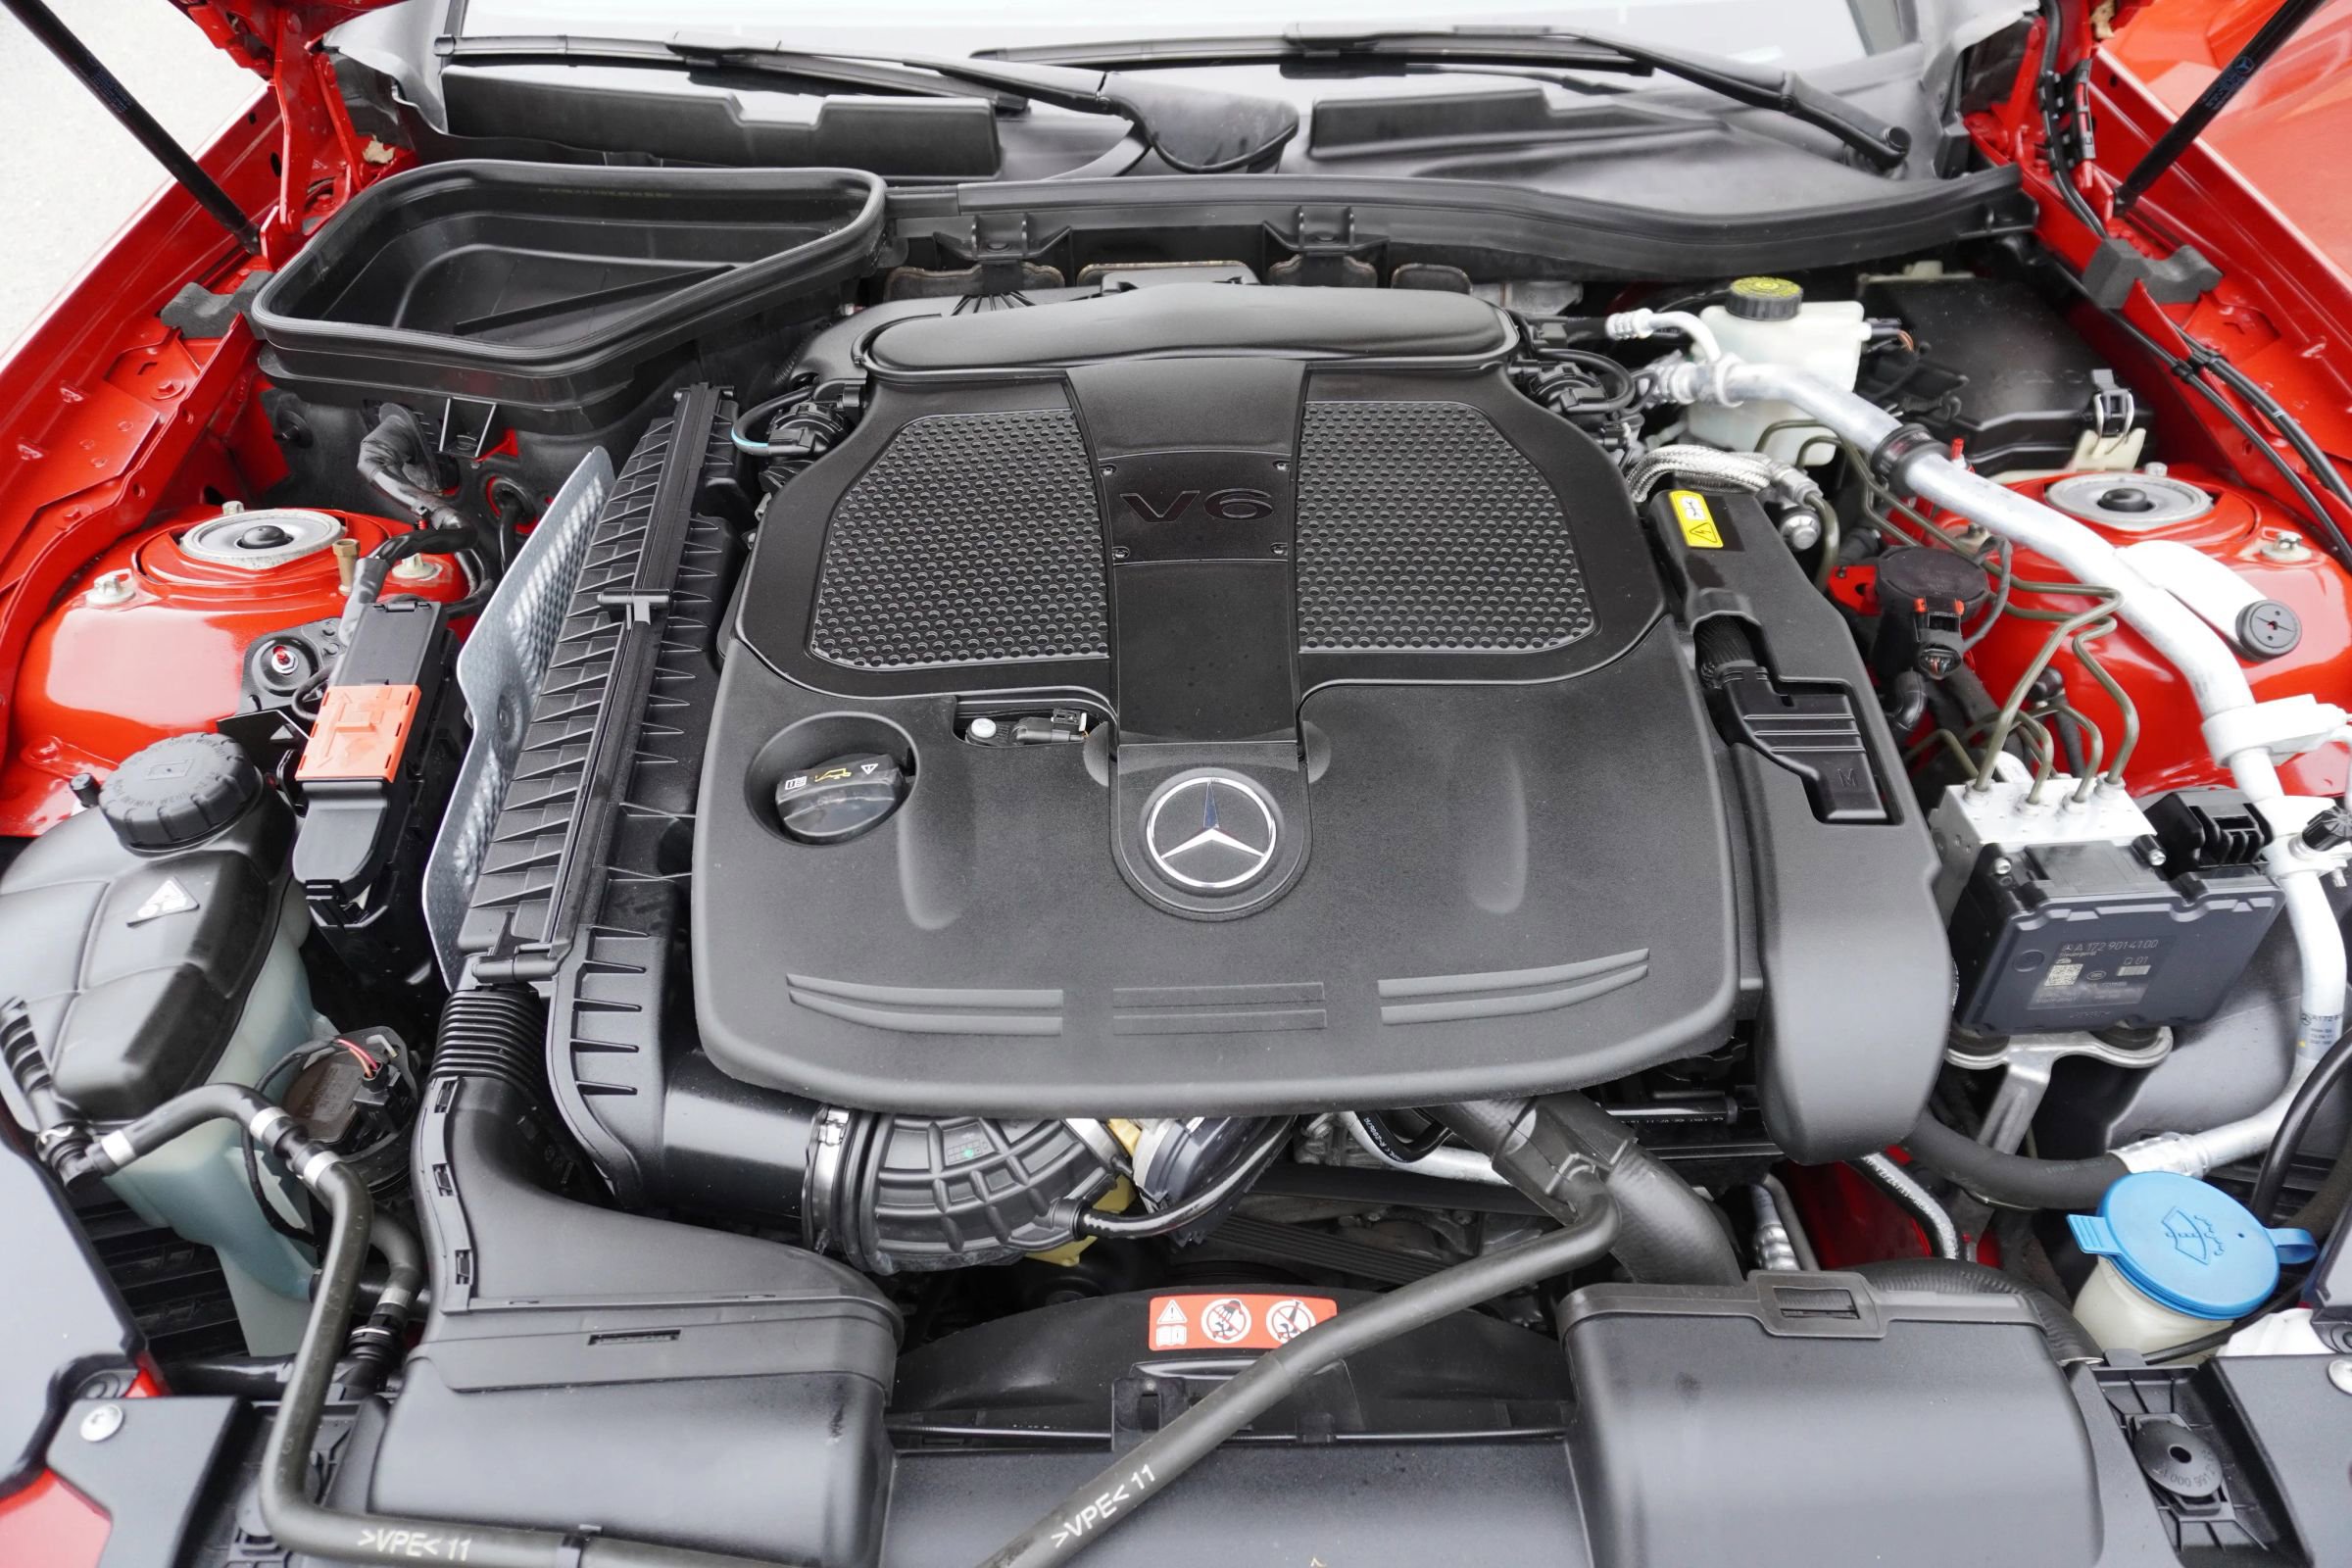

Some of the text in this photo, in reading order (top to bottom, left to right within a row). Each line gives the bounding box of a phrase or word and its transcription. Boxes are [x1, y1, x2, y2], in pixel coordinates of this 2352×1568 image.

[1119, 488, 1275, 523] V6
[1130, 1464, 1155, 1490] 11
[448, 1538, 472, 1561] 11
